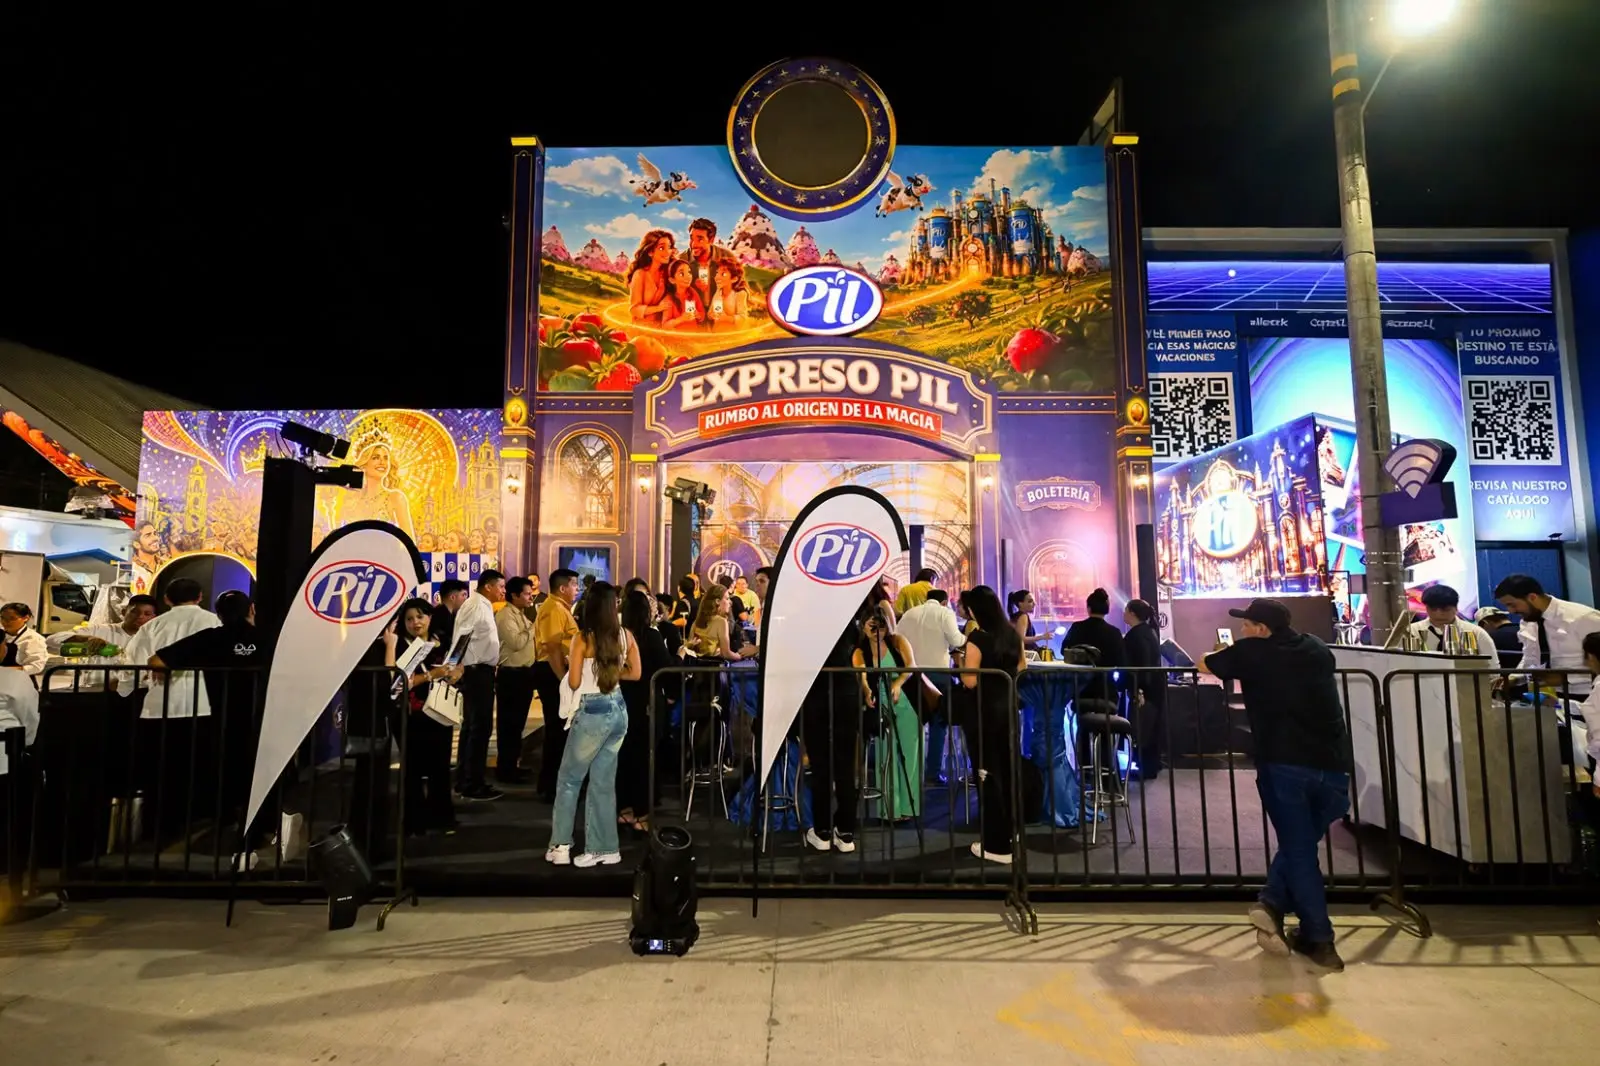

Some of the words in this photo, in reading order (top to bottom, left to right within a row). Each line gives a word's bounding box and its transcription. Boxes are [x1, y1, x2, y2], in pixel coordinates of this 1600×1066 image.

[1206, 329, 1231, 339] PASO
[1147, 341, 1164, 351] CIA
[1167, 342, 1191, 351] ESAS
[1193, 339, 1236, 351] MÁGICAS
[1510, 342, 1525, 352] TE
[1155, 353, 1216, 362] VACACIONES
[1474, 355, 1540, 366] BUSCANDO
[679, 357, 881, 413] EXPRESO
[890, 362, 959, 416] PIL
[704, 405, 760, 430] RUMBO
[762, 402, 781, 420] AL
[783, 400, 842, 418] ORIGEN
[844, 402, 861, 418] DE
[864, 403, 884, 420] LA
[885, 406, 935, 432] MAGIA
[1512, 480, 1568, 491] NUESTRO
[1026, 485, 1091, 503] BOLETERÍA
[1487, 491, 1550, 505] CATÁLOGO
[806, 527, 872, 576] Pil
[317, 565, 388, 613] Pil
